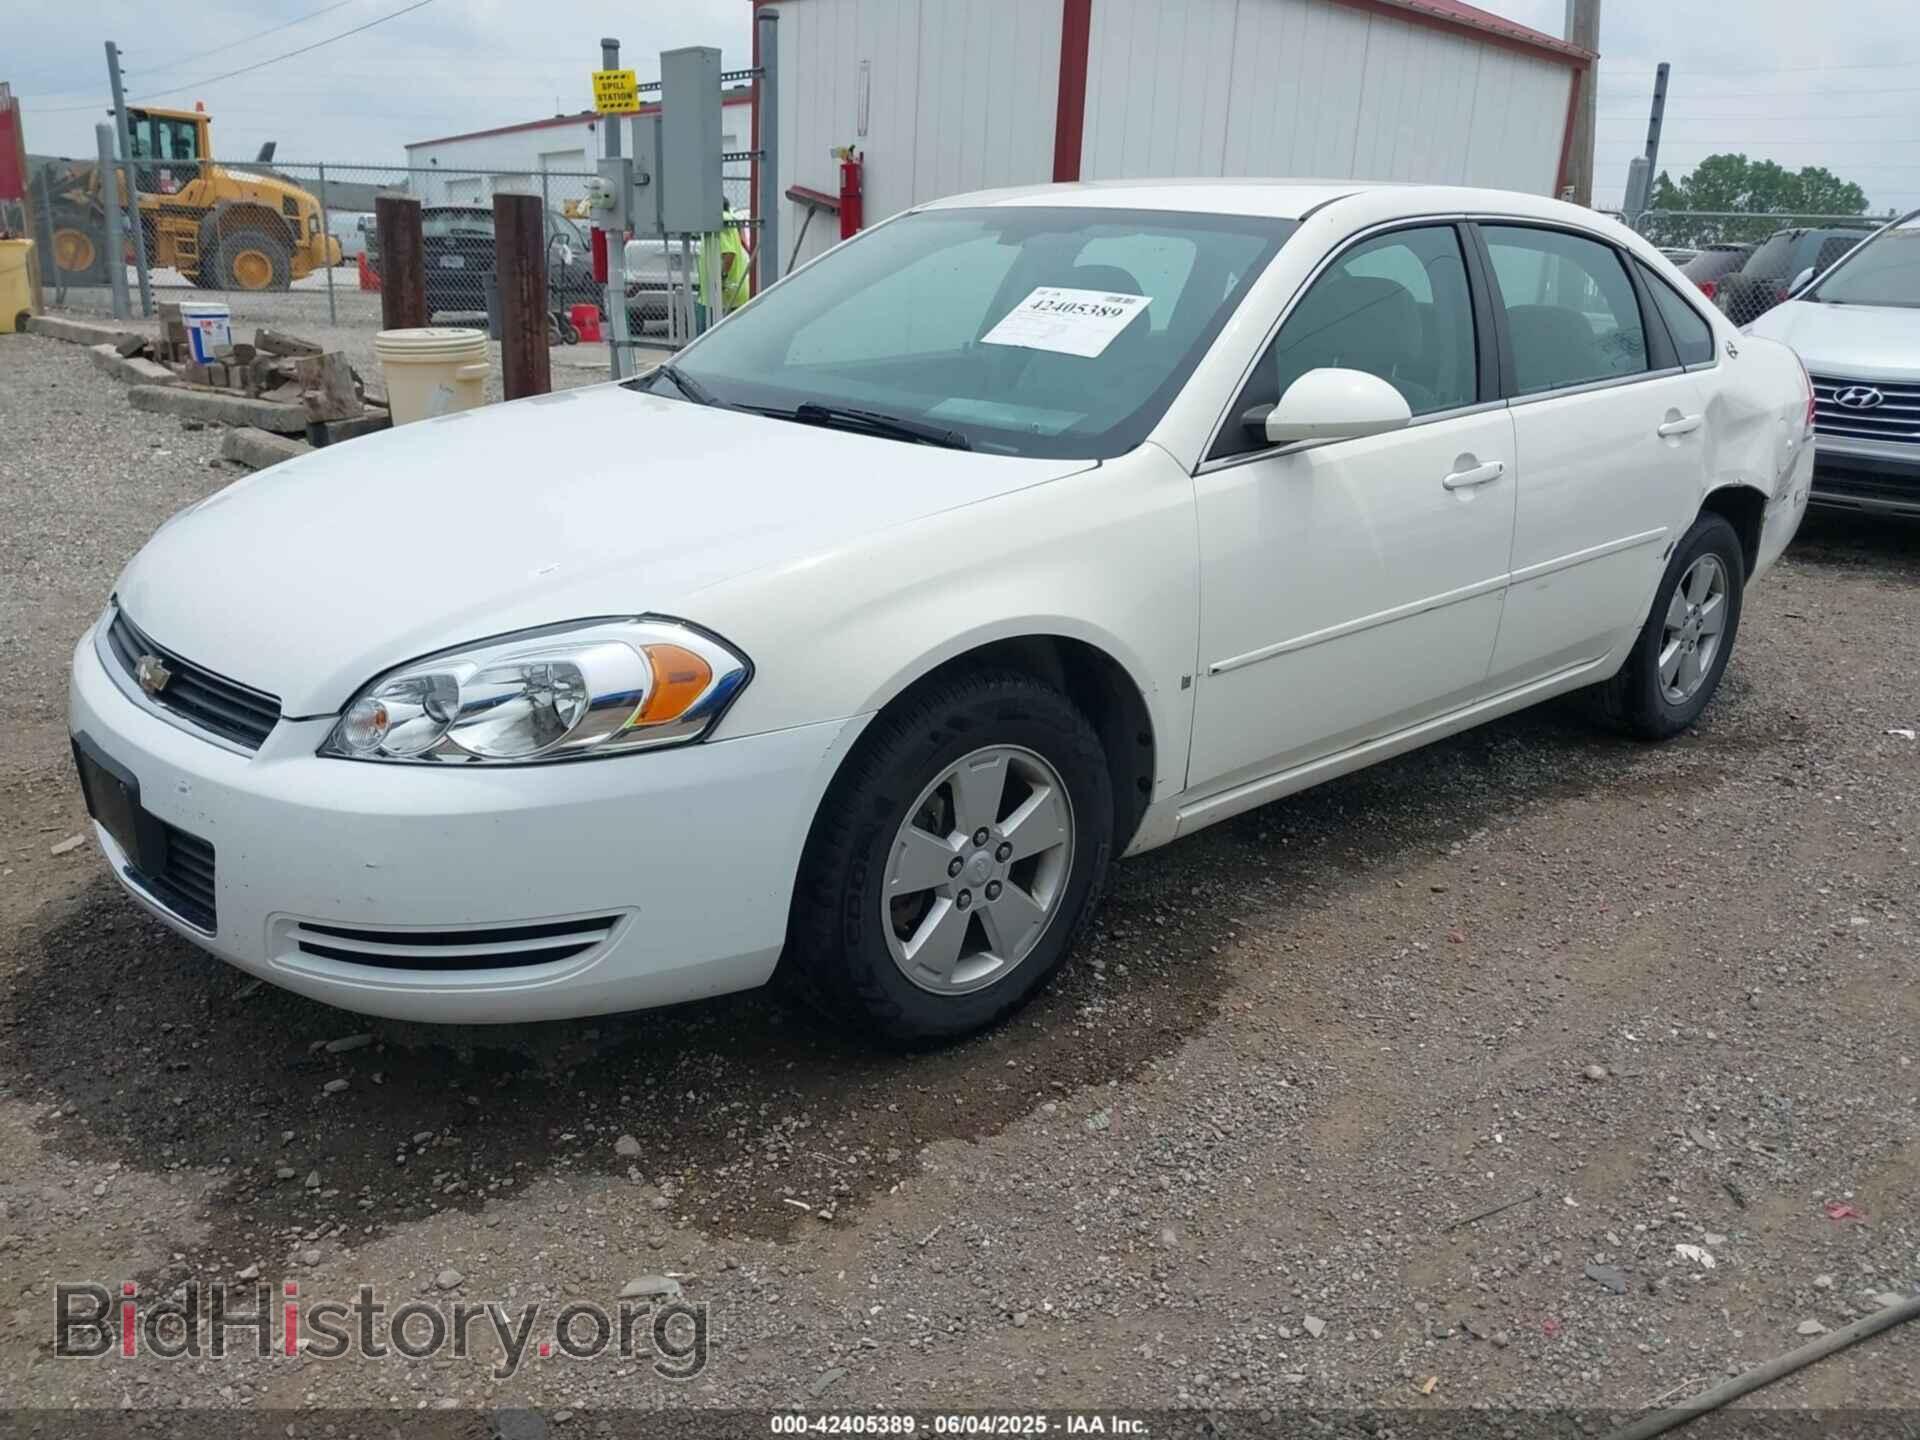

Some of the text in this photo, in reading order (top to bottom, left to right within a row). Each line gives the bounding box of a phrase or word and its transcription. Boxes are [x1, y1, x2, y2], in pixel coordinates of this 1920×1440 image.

[601, 82, 625, 90] SPILL
[598, 93, 633, 102] STATION
[1030, 300, 1124, 318] 42405389
